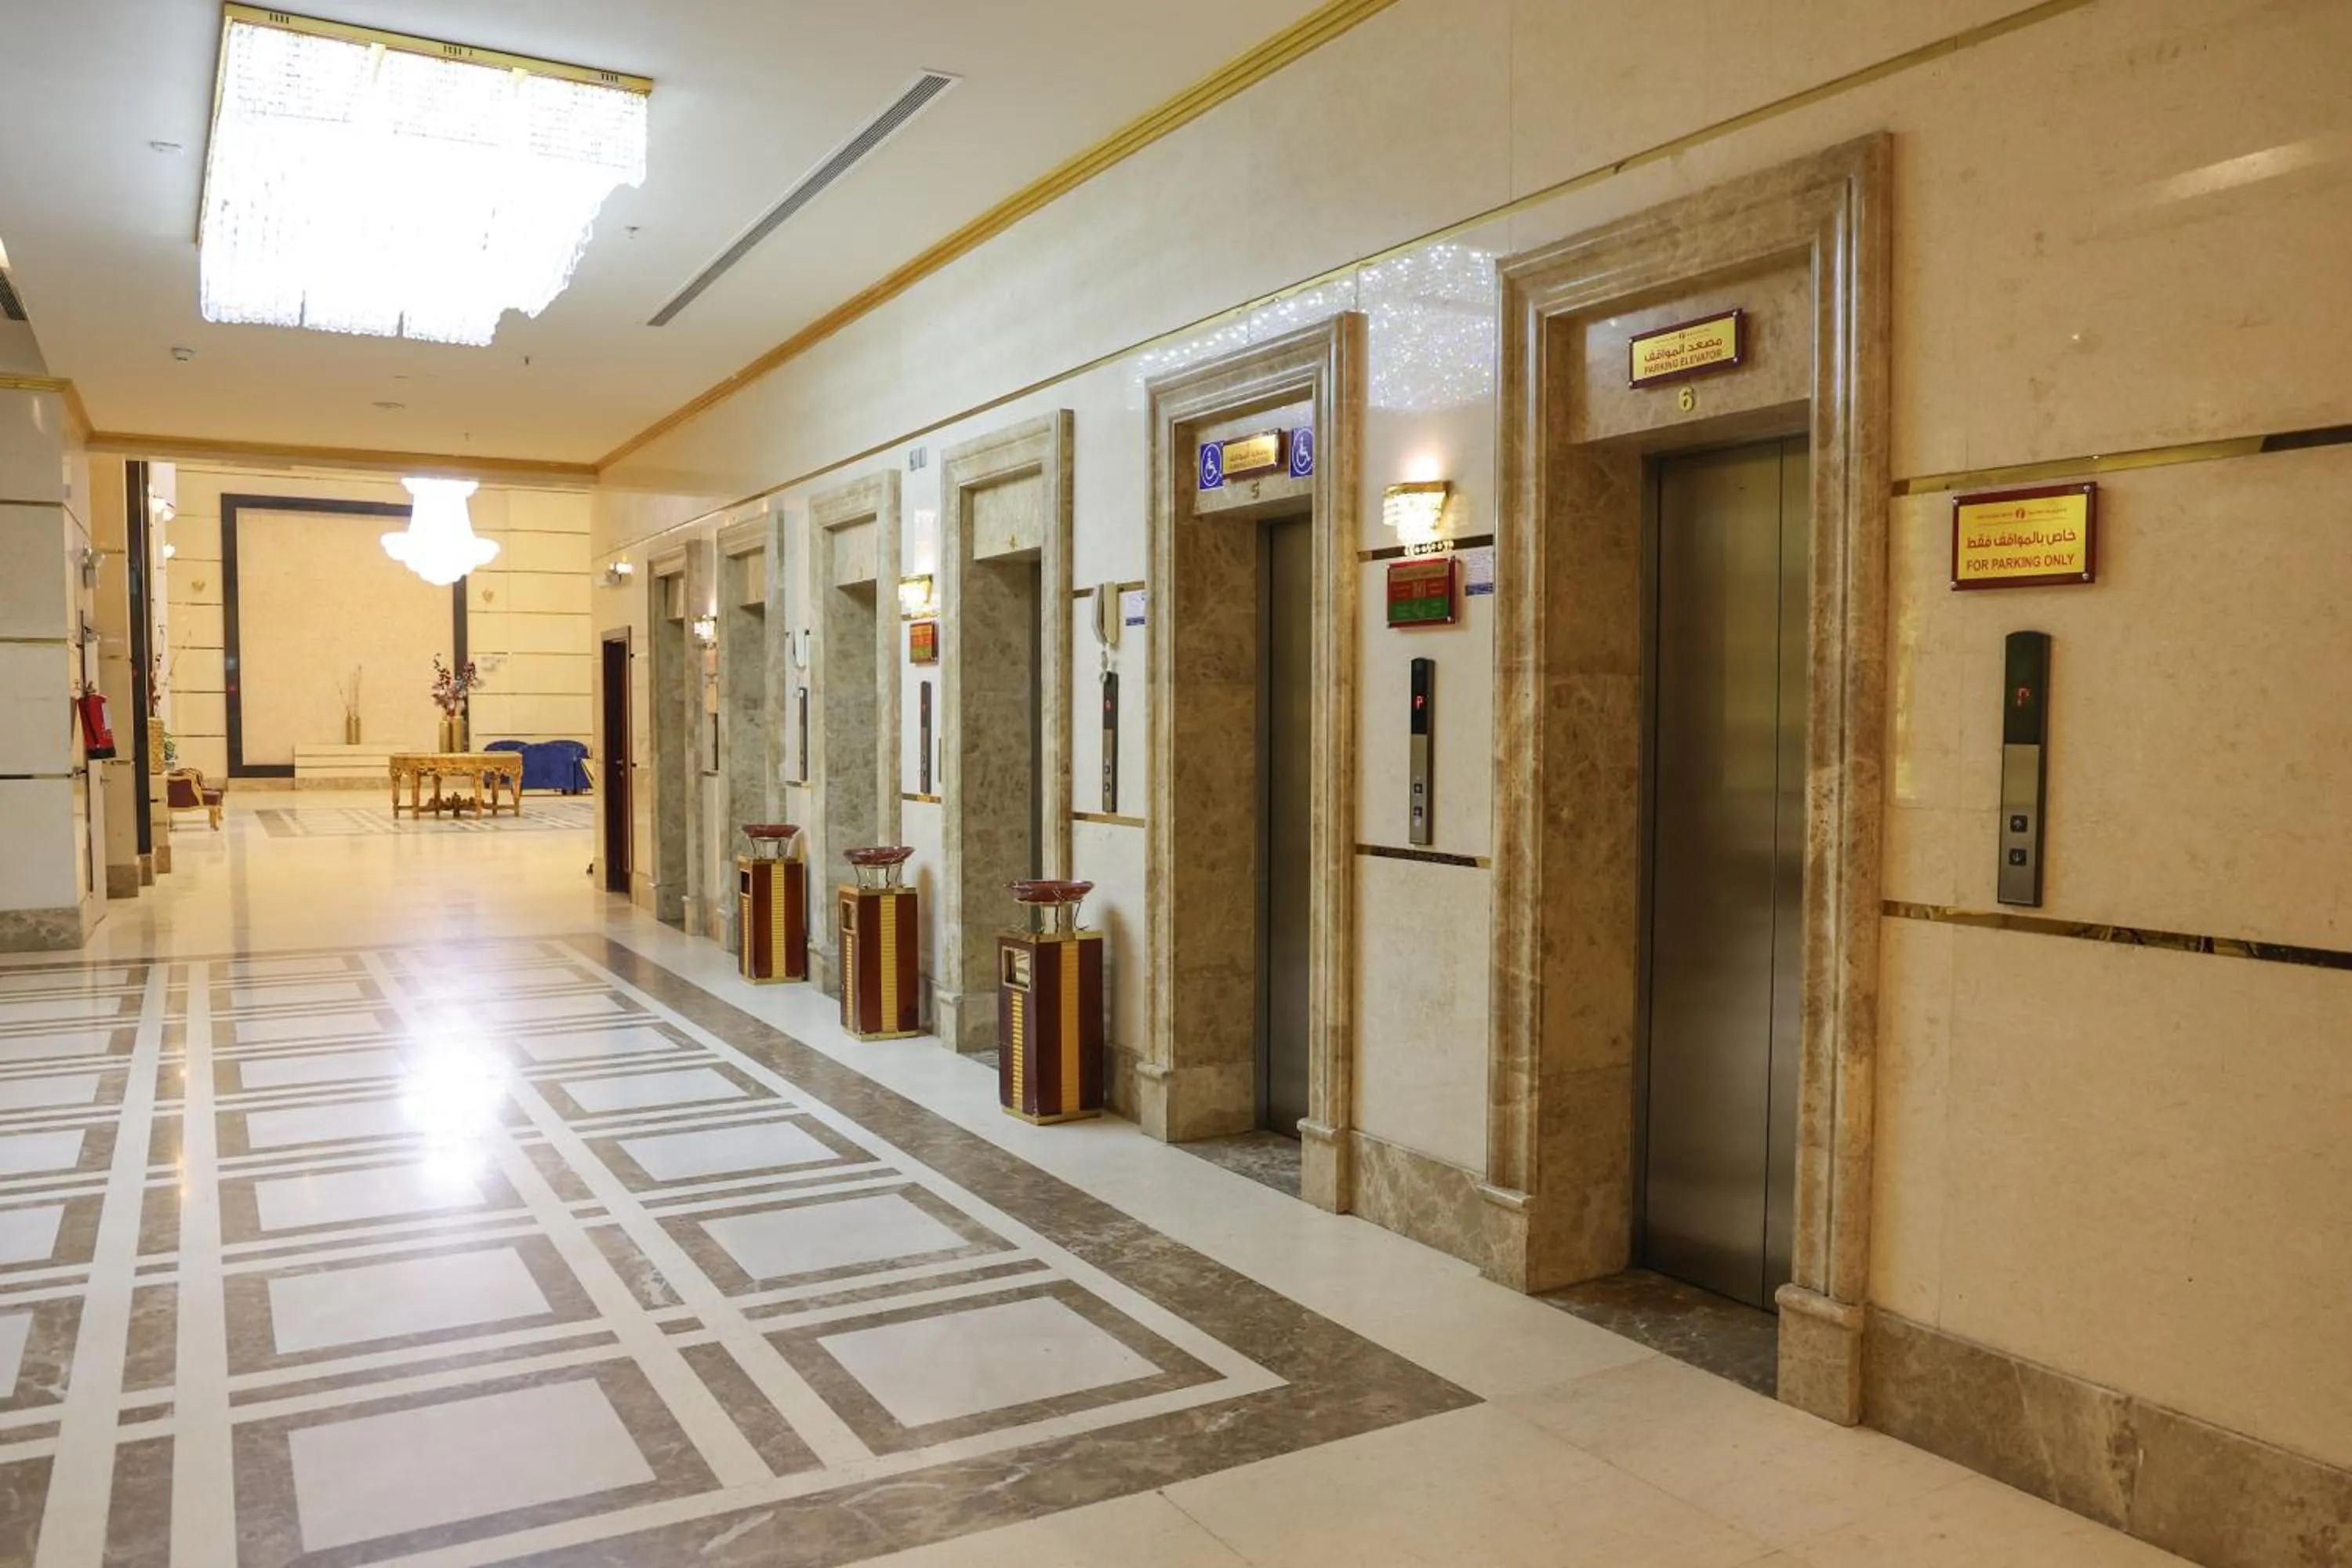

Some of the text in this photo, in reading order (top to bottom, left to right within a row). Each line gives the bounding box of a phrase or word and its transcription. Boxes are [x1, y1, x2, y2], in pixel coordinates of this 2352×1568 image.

[1644, 343, 1685, 362] المواقف
[1687, 338, 1722, 351] مصعد
[1644, 349, 1723, 375] PARKING ELEVATOR
[1679, 387, 1694, 412] 6
[1967, 528, 2077, 549] خاص بالمواقف فقط
[1966, 554, 2075, 572] FOR PARKING ONLY
[1416, 695, 1424, 709] P
